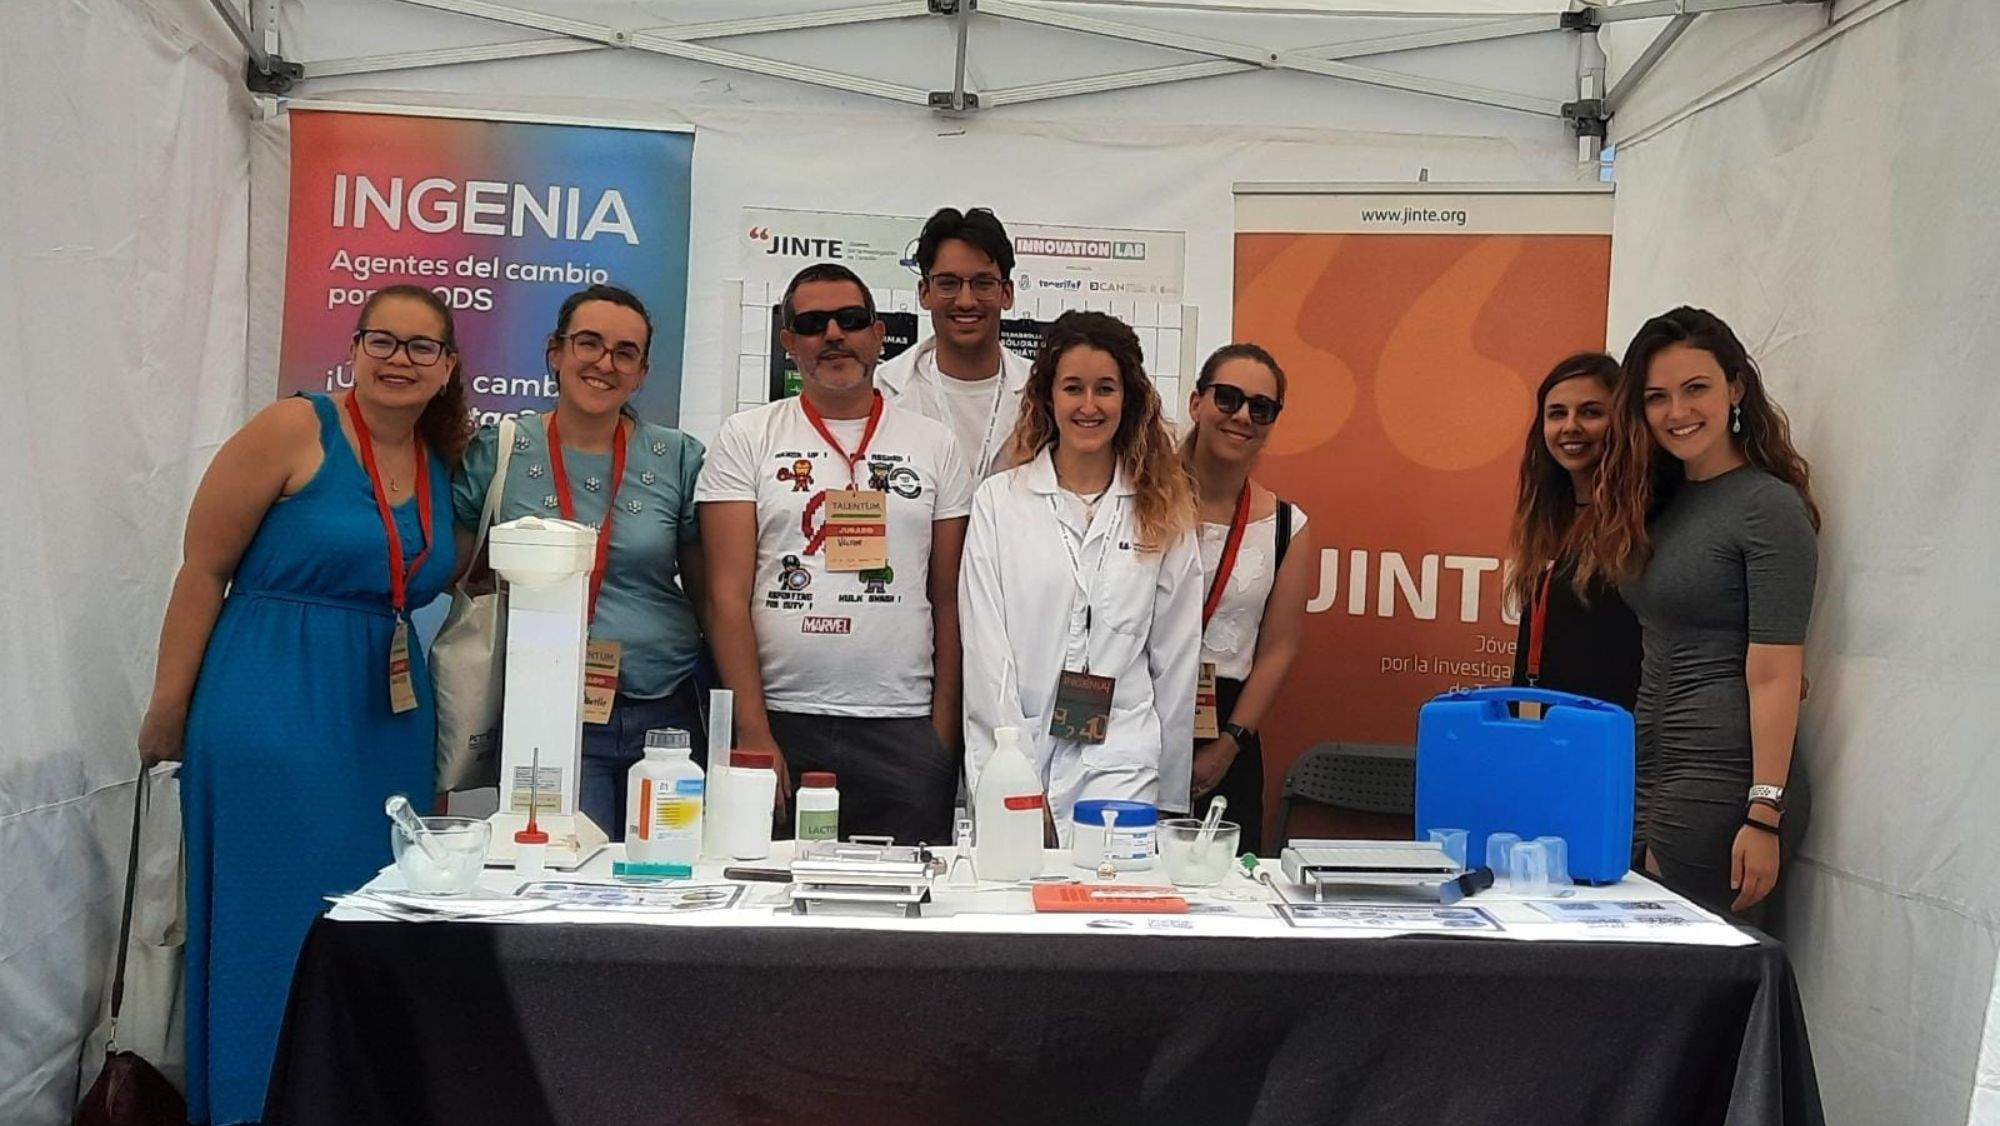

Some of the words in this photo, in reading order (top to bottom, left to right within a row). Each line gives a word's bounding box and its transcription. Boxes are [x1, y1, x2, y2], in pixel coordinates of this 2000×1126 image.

[331, 174, 640, 245] INGENIA
[1361, 207, 1467, 226] www.jinte.org
[766, 235, 843, 259] JINTE
[1016, 239, 1110, 257] INNOVATION
[1113, 243, 1145, 259] LAB
[329, 250, 449, 280] Agentes
[455, 255, 499, 279] del
[505, 263, 609, 285] cambio
[832, 502, 880, 511] TALENTUM
[804, 617, 849, 632] MARVEL
[1474, 634, 1517, 654] Jóve
[1381, 657, 1411, 673] por
[1414, 655, 1428, 672] la
[1433, 656, 1514, 681] Investiga
